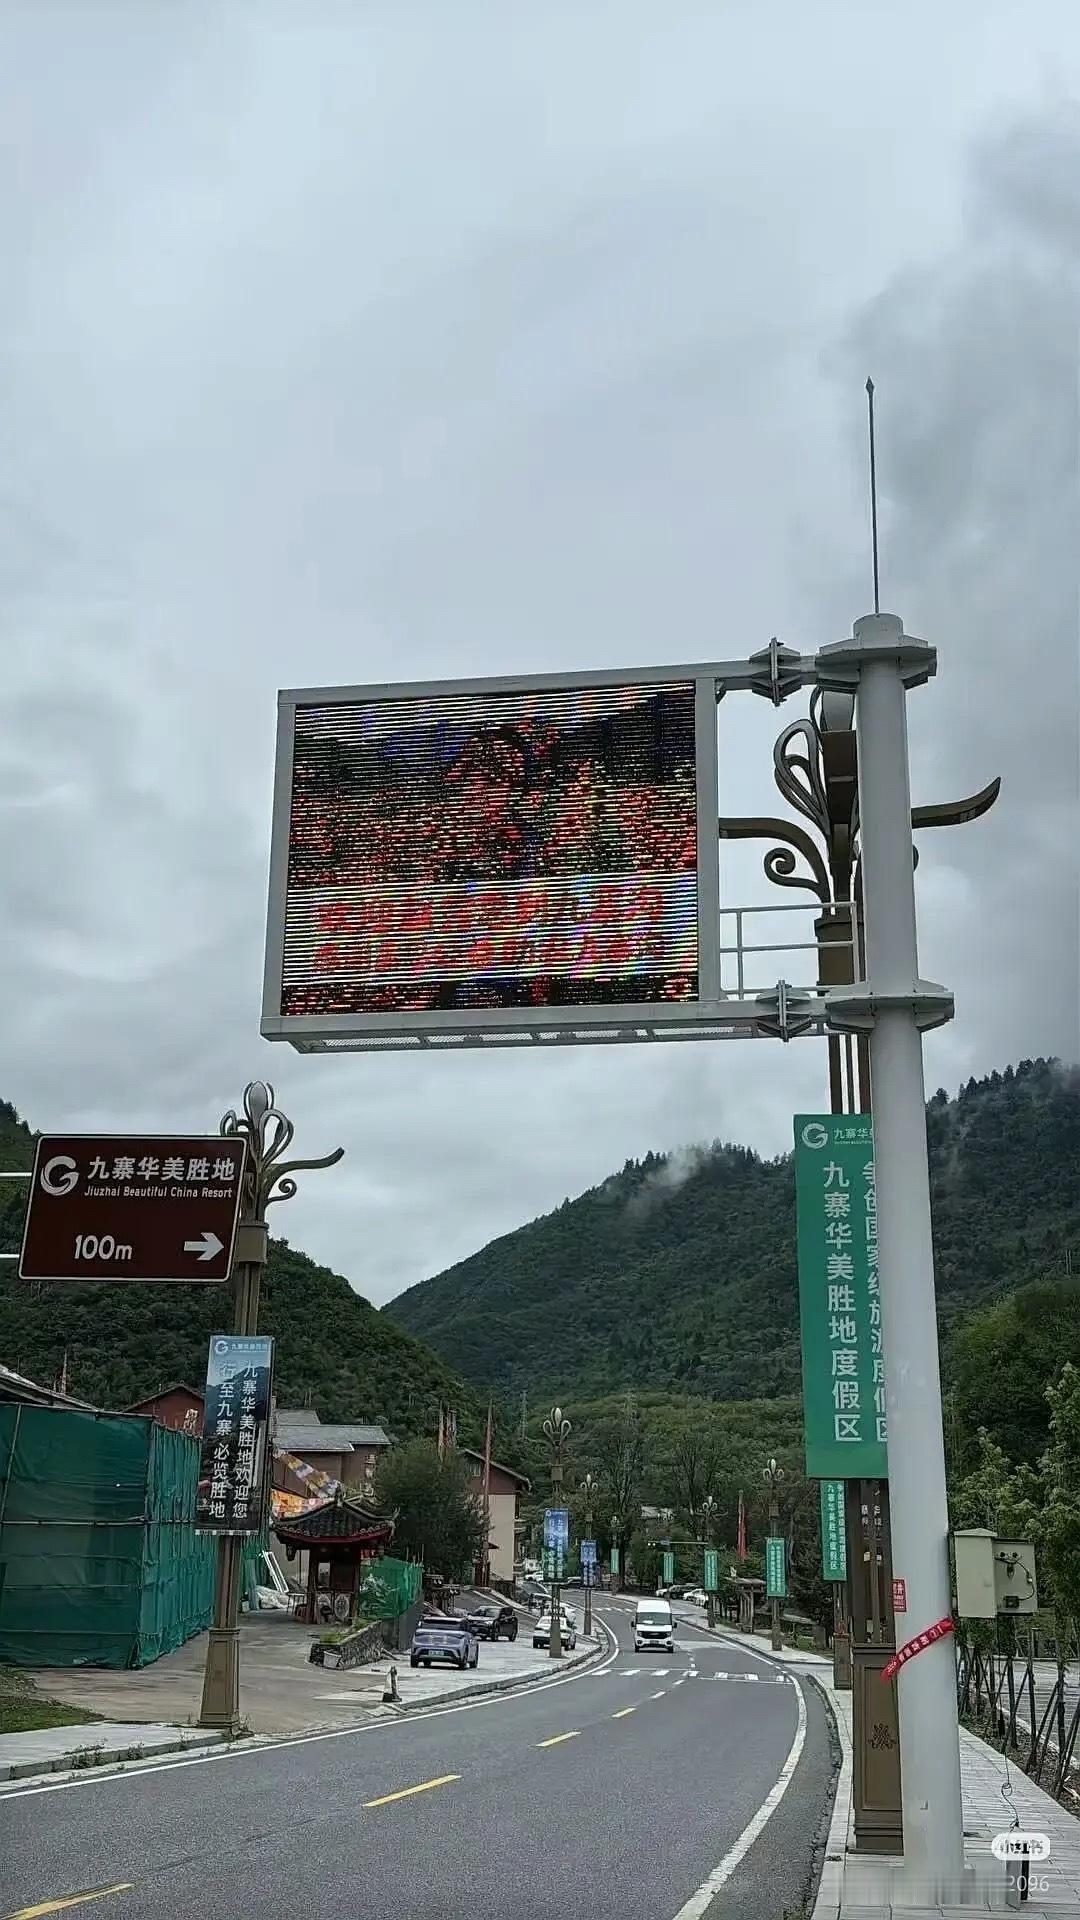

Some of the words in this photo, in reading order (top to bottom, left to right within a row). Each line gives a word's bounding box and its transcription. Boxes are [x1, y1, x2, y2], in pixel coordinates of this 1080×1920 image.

[833, 1127, 873, 1140] 九寨华
[87, 1156, 235, 1182] 九寨华美胜地
[84, 1185, 121, 1197] Jiuzhai
[123, 1186, 168, 1198] Beautiful
[170, 1186, 199, 1198] China
[201, 1186, 233, 1199] Resort
[74, 1234, 133, 1260] 100m
[823, 1160, 863, 1442] 九寨华美胜地度假区
[232, 1359, 258, 1519] 九寨华美胜地欢迎您
